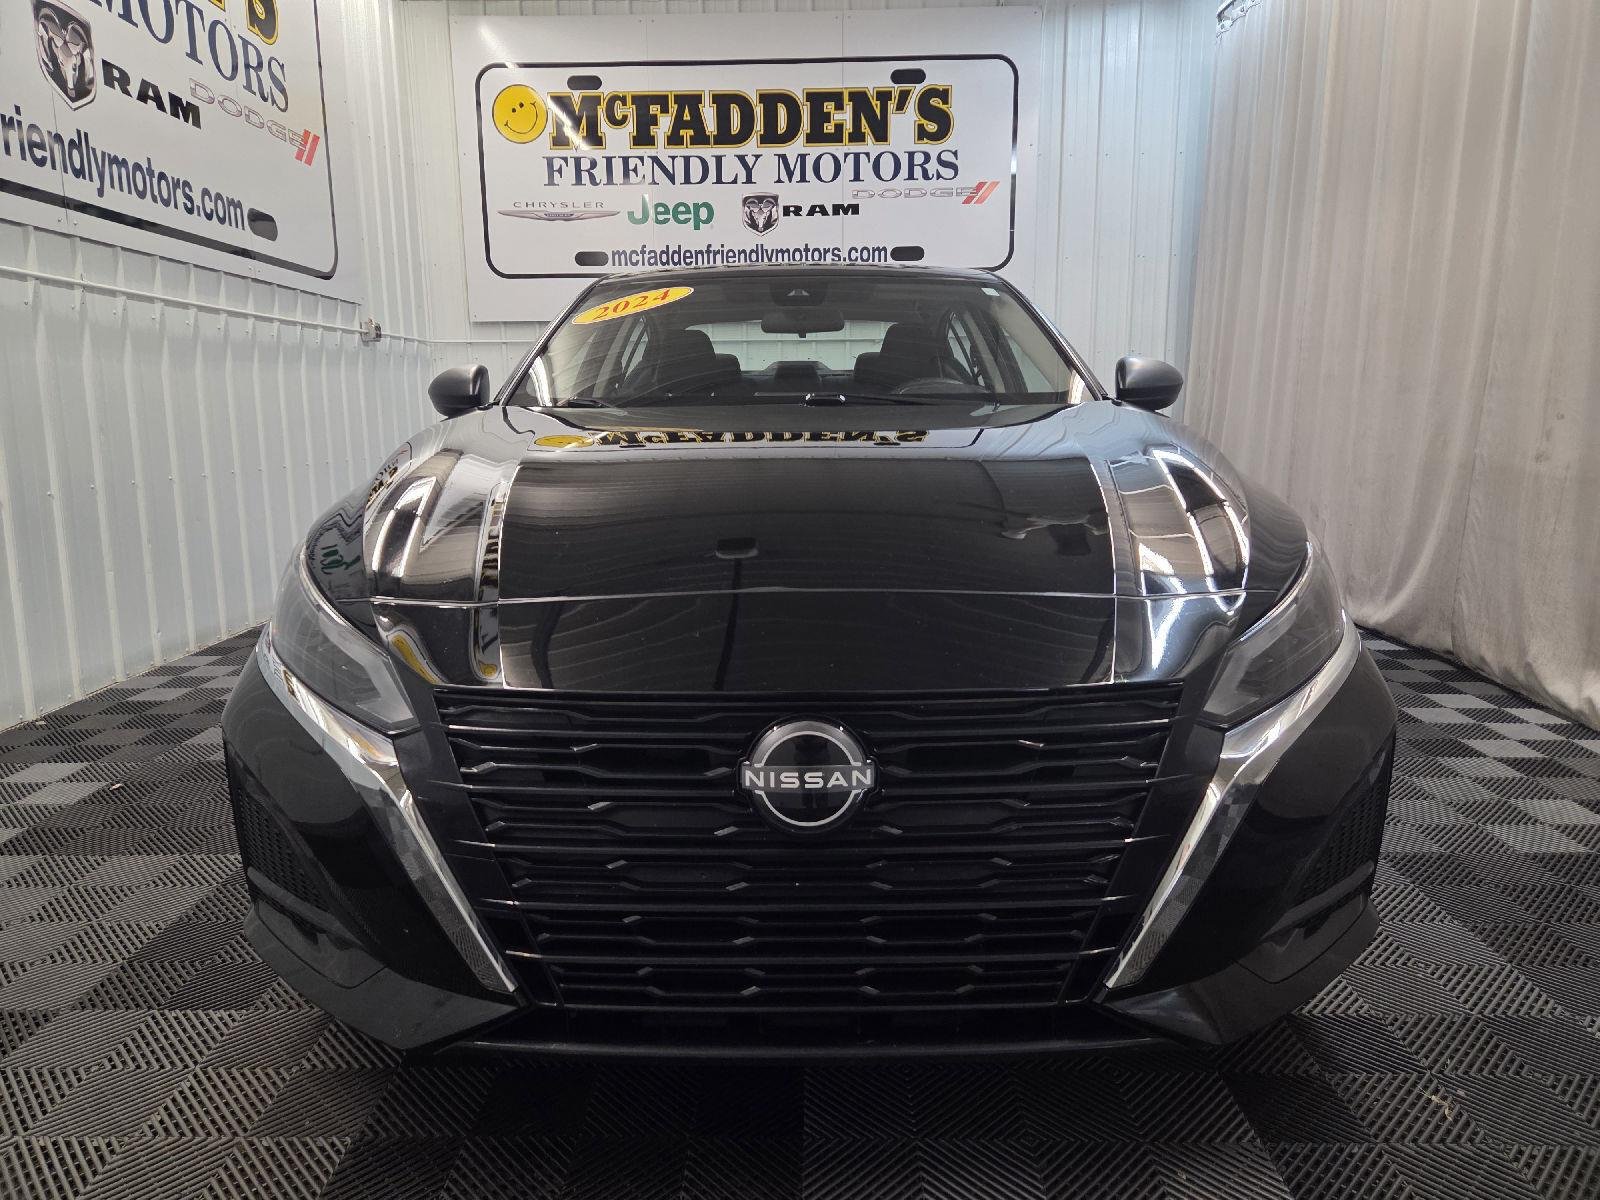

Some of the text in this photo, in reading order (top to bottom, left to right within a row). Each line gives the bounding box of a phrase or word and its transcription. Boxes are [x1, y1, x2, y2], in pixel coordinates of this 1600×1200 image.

[101, 58, 202, 130] RAM
[189, 77, 307, 152] DODGE
[542, 150, 959, 187] FRIENDLY MOTORS
[513, 201, 605, 209] CHRYSLER
[851, 186, 979, 200] DODGE
[627, 193, 715, 230] Jeep
[782, 203, 860, 217] RAM
[611, 244, 888, 267] mcfaddenfriendlymotors.com
[593, 289, 671, 321] 2024
[745, 769, 872, 789] NISSAN
